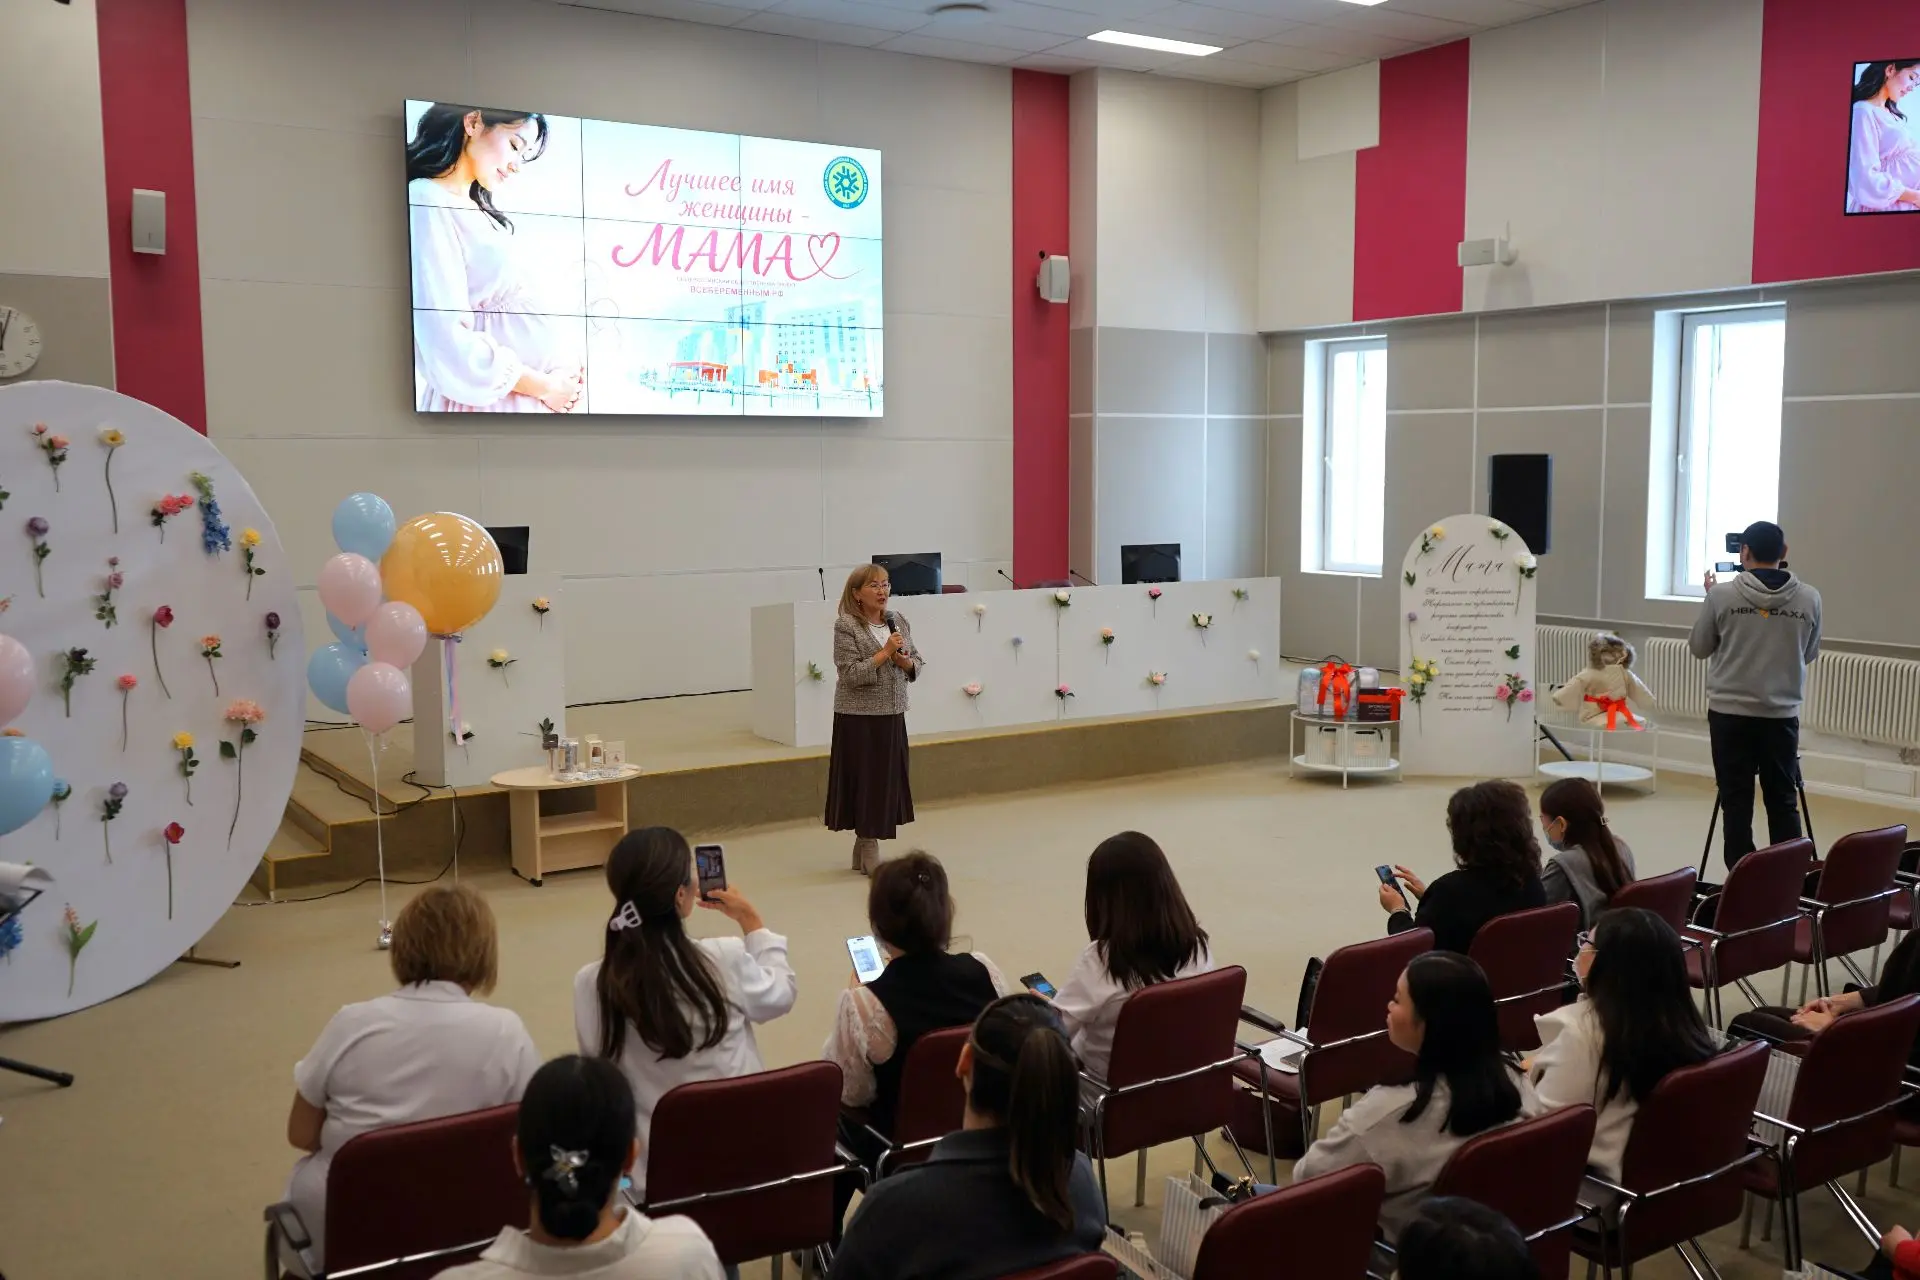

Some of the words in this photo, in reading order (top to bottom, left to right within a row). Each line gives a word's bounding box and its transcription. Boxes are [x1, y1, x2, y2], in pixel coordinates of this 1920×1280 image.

[624, 159, 741, 202] Лучшее
[751, 177, 796, 196] имя
[678, 200, 793, 225] женщины
[611, 223, 808, 281] МАМА
[1427, 544, 1504, 583] Мама
[1730, 607, 1758, 616] НВК
[1769, 608, 1807, 621] САХА
